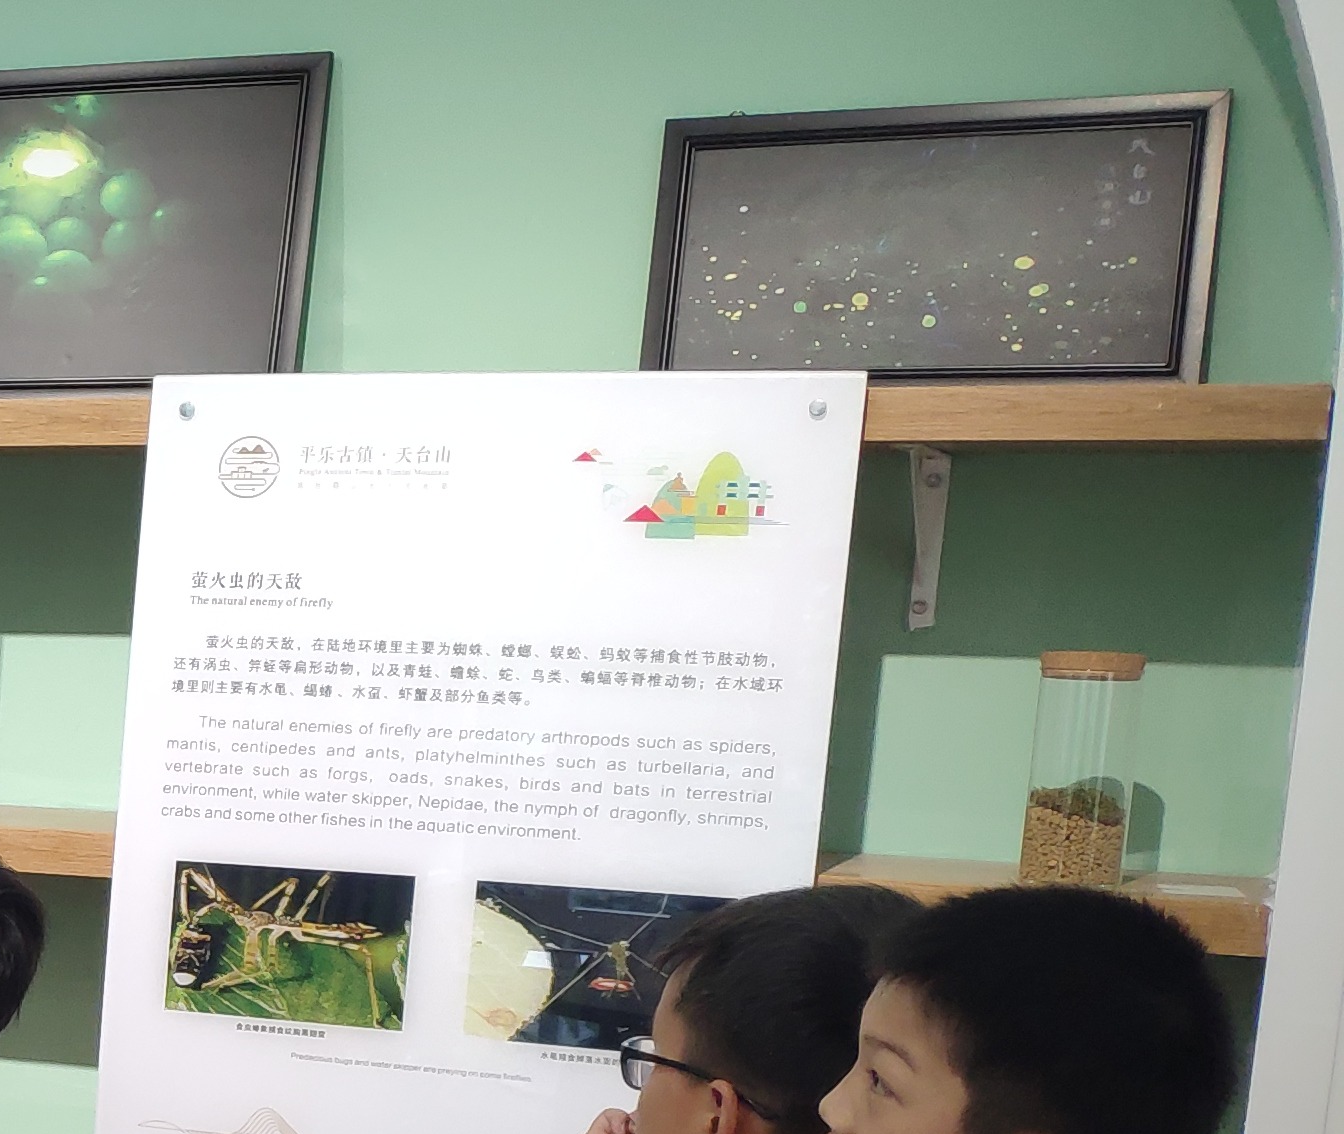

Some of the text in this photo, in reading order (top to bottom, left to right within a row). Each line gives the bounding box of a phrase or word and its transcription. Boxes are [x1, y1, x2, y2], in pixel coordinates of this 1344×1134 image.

[191, 571, 303, 590] 萤火虫的天敌
[189, 595, 334, 610] The natural enemy of firefly
[198, 715, 776, 757] The natural enemies of firefly are predatory arthropods such as spiders,
[166, 739, 775, 779] mantis, centipedes and ants, platyhelminthes such as turbellaria, and
[164, 761, 244, 775] vertebrate
[252, 765, 290, 777] such
[298, 769, 318, 778] as
[327, 767, 373, 783] forgs,
[444, 775, 509, 791] snakes,
[519, 777, 561, 791] birds
[570, 781, 603, 793] and
[613, 782, 650, 796] bats
[660, 785, 676, 798] in
[686, 787, 773, 803] terrestrial
[160, 805, 581, 840] crabs and some other fishes in the aquatic environment.
[162, 783, 769, 830] environment, while water skipper, Nepidae, the nymph of dragonfly, shrimps,
